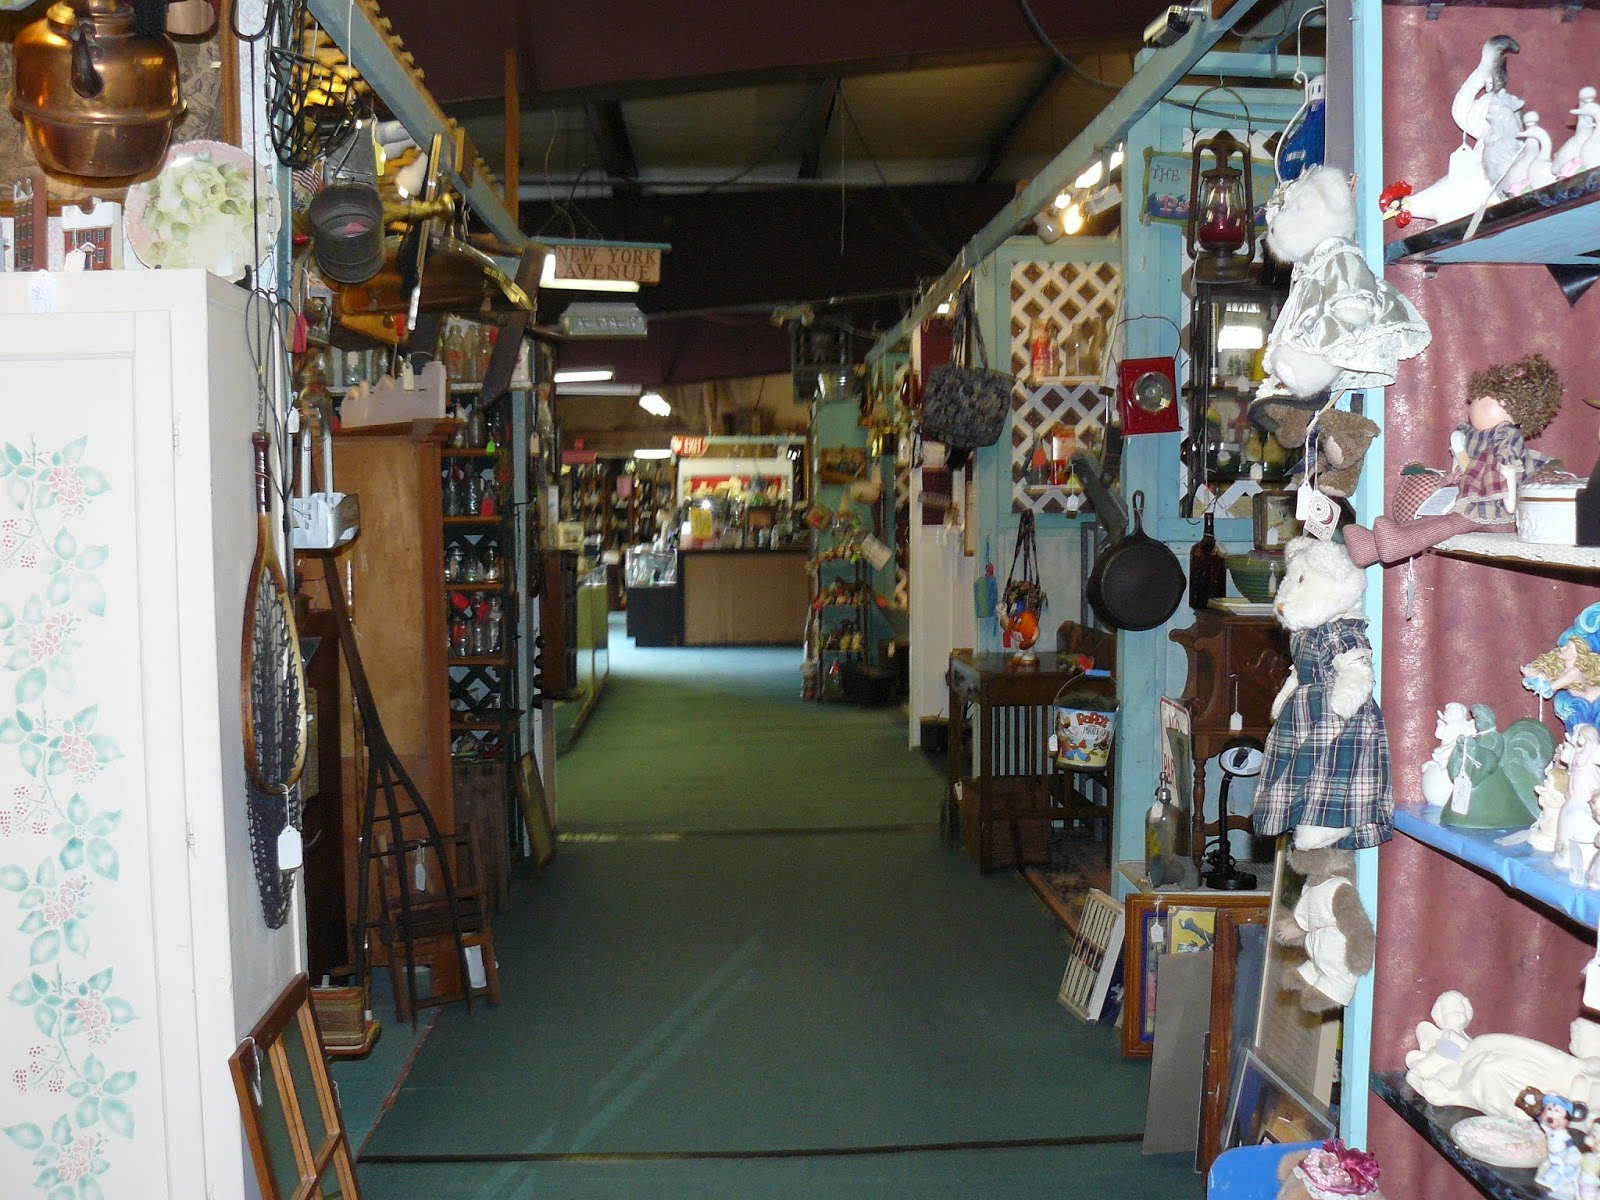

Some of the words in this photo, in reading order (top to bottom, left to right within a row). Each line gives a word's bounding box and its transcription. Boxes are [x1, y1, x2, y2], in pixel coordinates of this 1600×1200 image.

[1151, 165, 1180, 182] THE
[558, 248, 595, 263] NEW
[608, 249, 657, 265] YORK
[565, 264, 650, 281] AVENUE
[684, 437, 703, 454] EXIT
[1076, 713, 1110, 728] POPEYE
